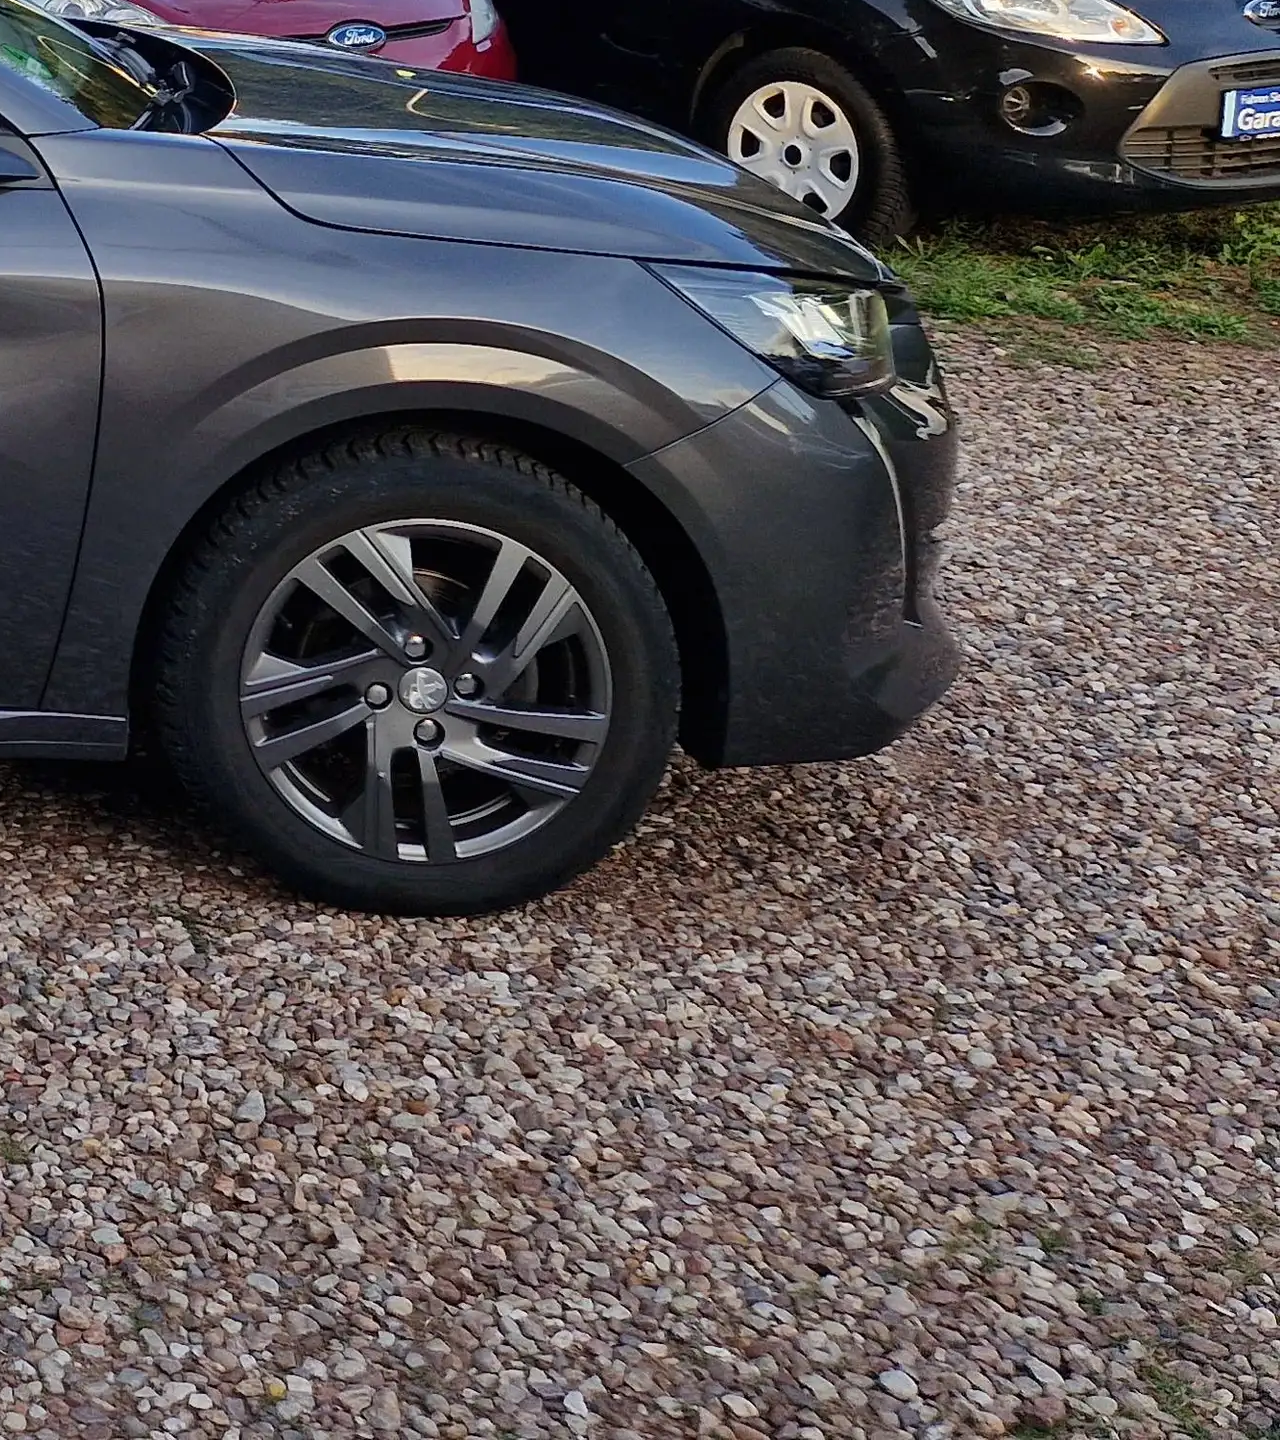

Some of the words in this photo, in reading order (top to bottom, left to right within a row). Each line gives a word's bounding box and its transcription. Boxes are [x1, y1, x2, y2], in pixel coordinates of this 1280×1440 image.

[1259, 1, 1280, 18] For
[344, 28, 376, 45] Ford
[1237, 107, 1280, 131] Gara
